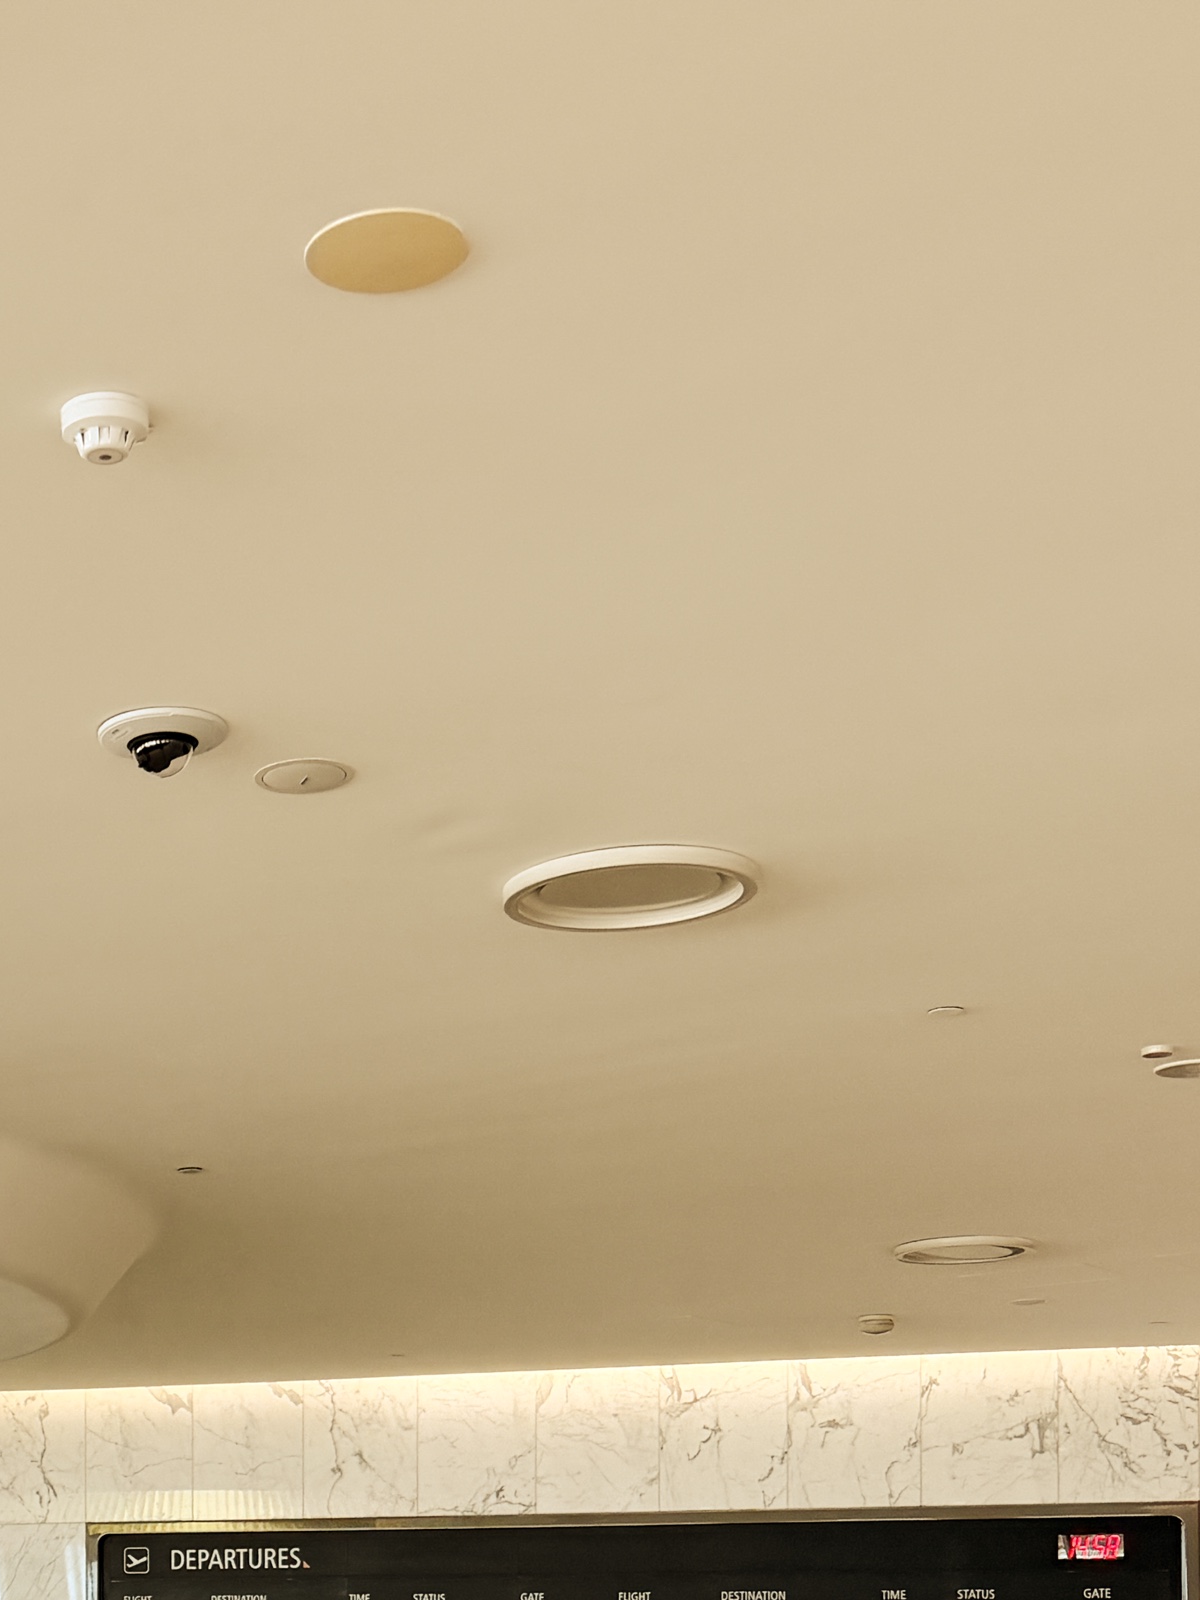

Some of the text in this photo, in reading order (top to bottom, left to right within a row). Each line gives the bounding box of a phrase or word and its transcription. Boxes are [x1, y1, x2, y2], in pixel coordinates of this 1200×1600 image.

[881, 1589, 907, 1600] TIME
[956, 1588, 995, 1600] STATUS
[1083, 1587, 1112, 1599] GATE
